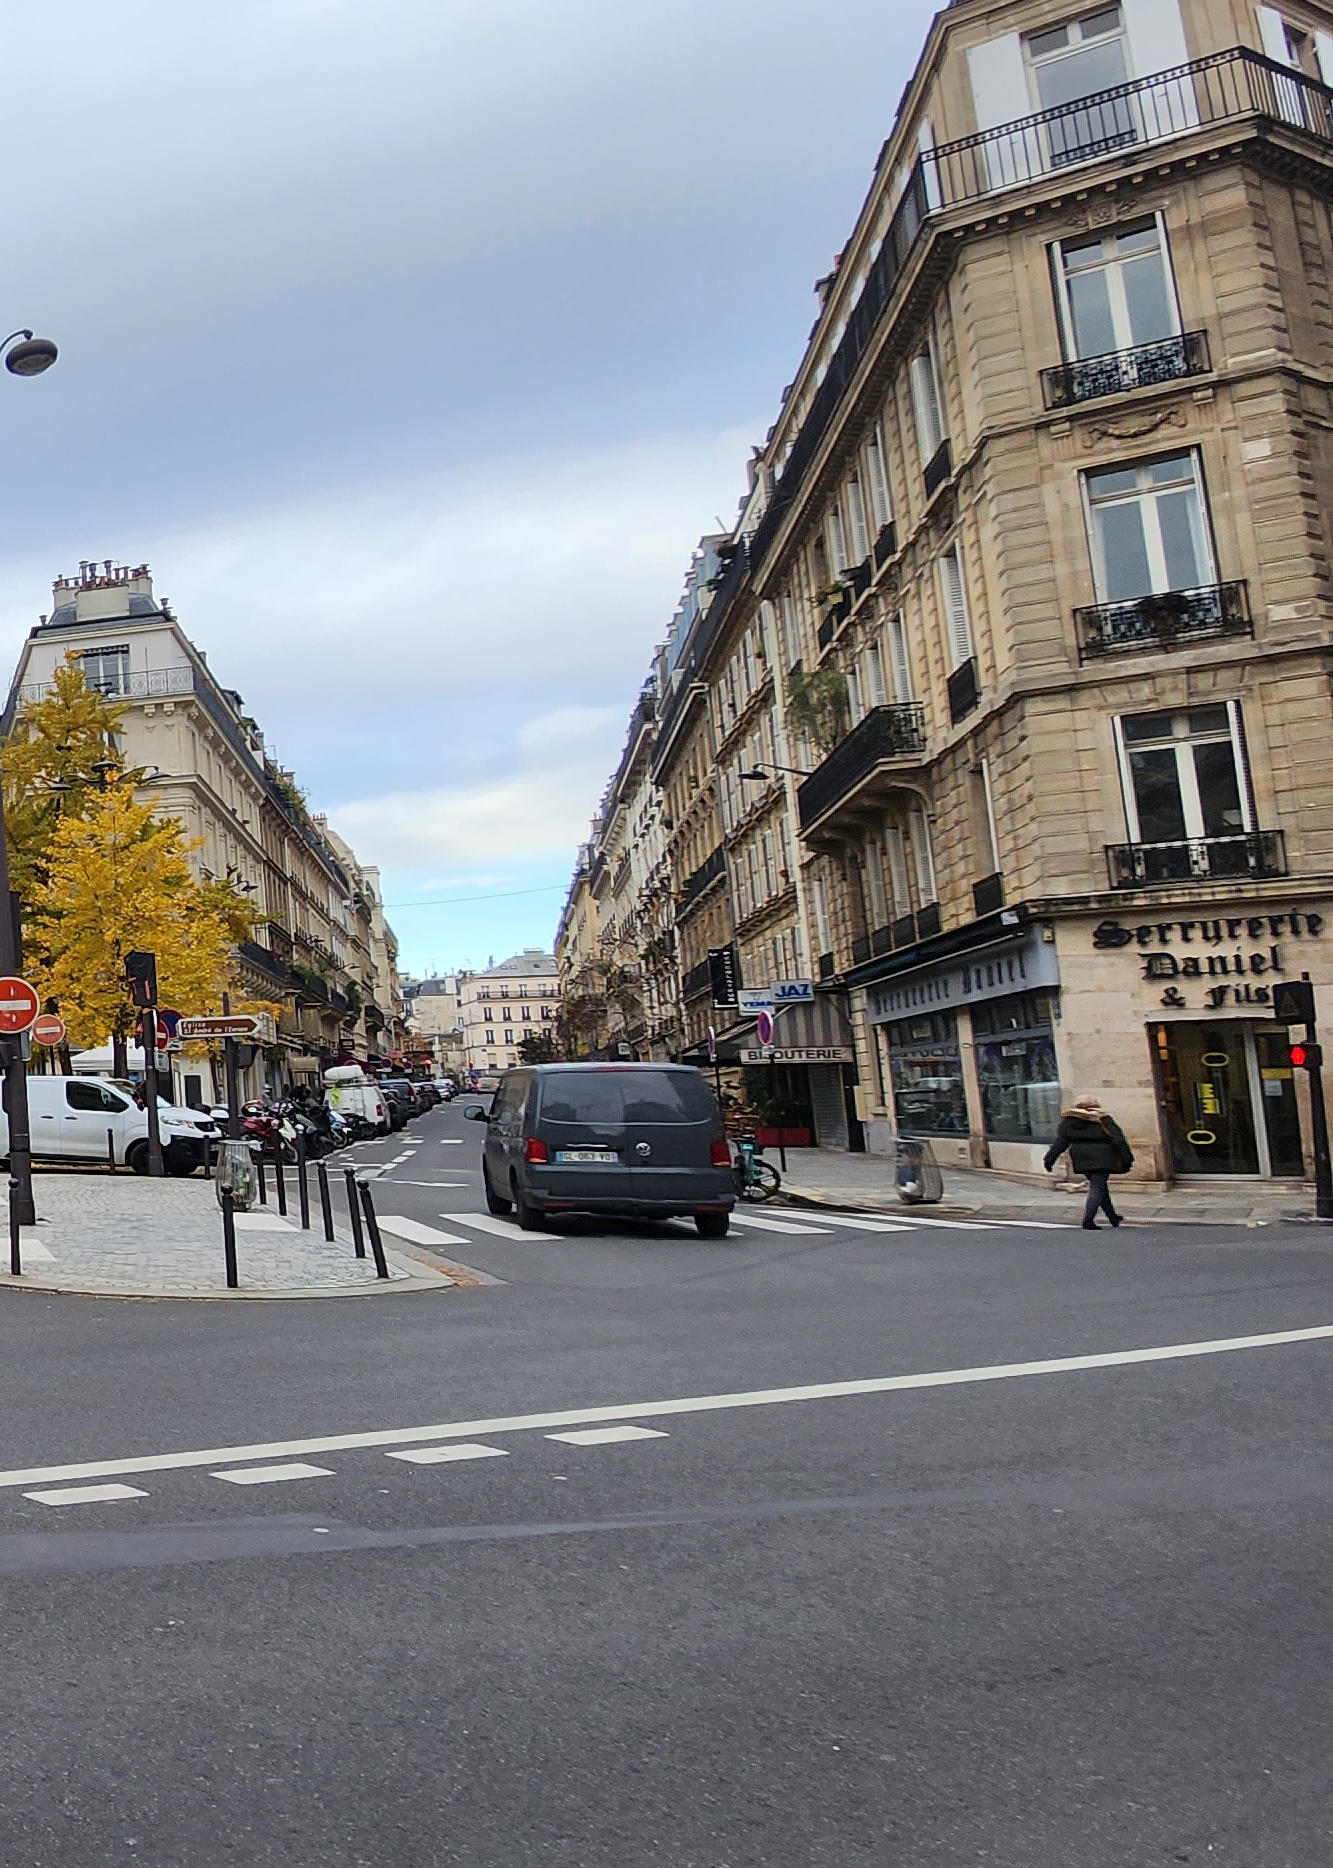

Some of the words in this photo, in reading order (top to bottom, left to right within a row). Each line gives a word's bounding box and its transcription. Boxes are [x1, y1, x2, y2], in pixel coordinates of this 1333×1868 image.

[1093, 908, 1323, 948] Serrurerie
[1136, 944, 1285, 980] Daniel
[774, 983, 812, 997] JAZ
[1160, 986, 1186, 1007] &
[1204, 982, 1271, 1009] Fils
